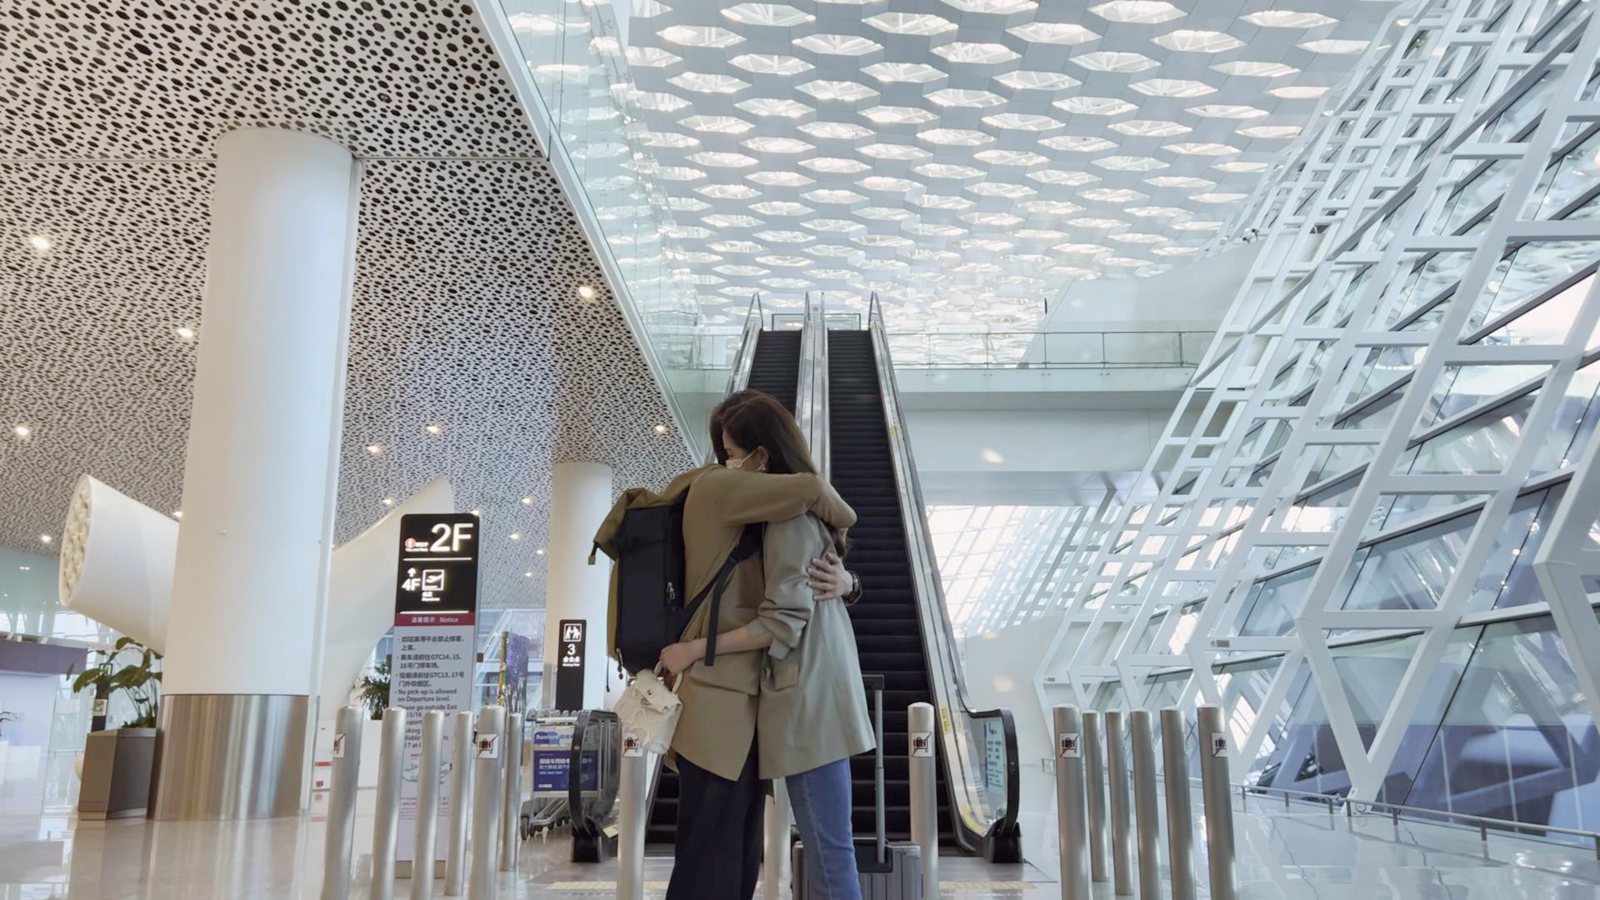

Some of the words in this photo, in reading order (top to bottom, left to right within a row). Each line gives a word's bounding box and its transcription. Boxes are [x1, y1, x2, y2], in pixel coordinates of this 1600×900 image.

[430, 523, 474, 552] 2F
[401, 578, 421, 591] 4F
[567, 643, 576, 656] 3
